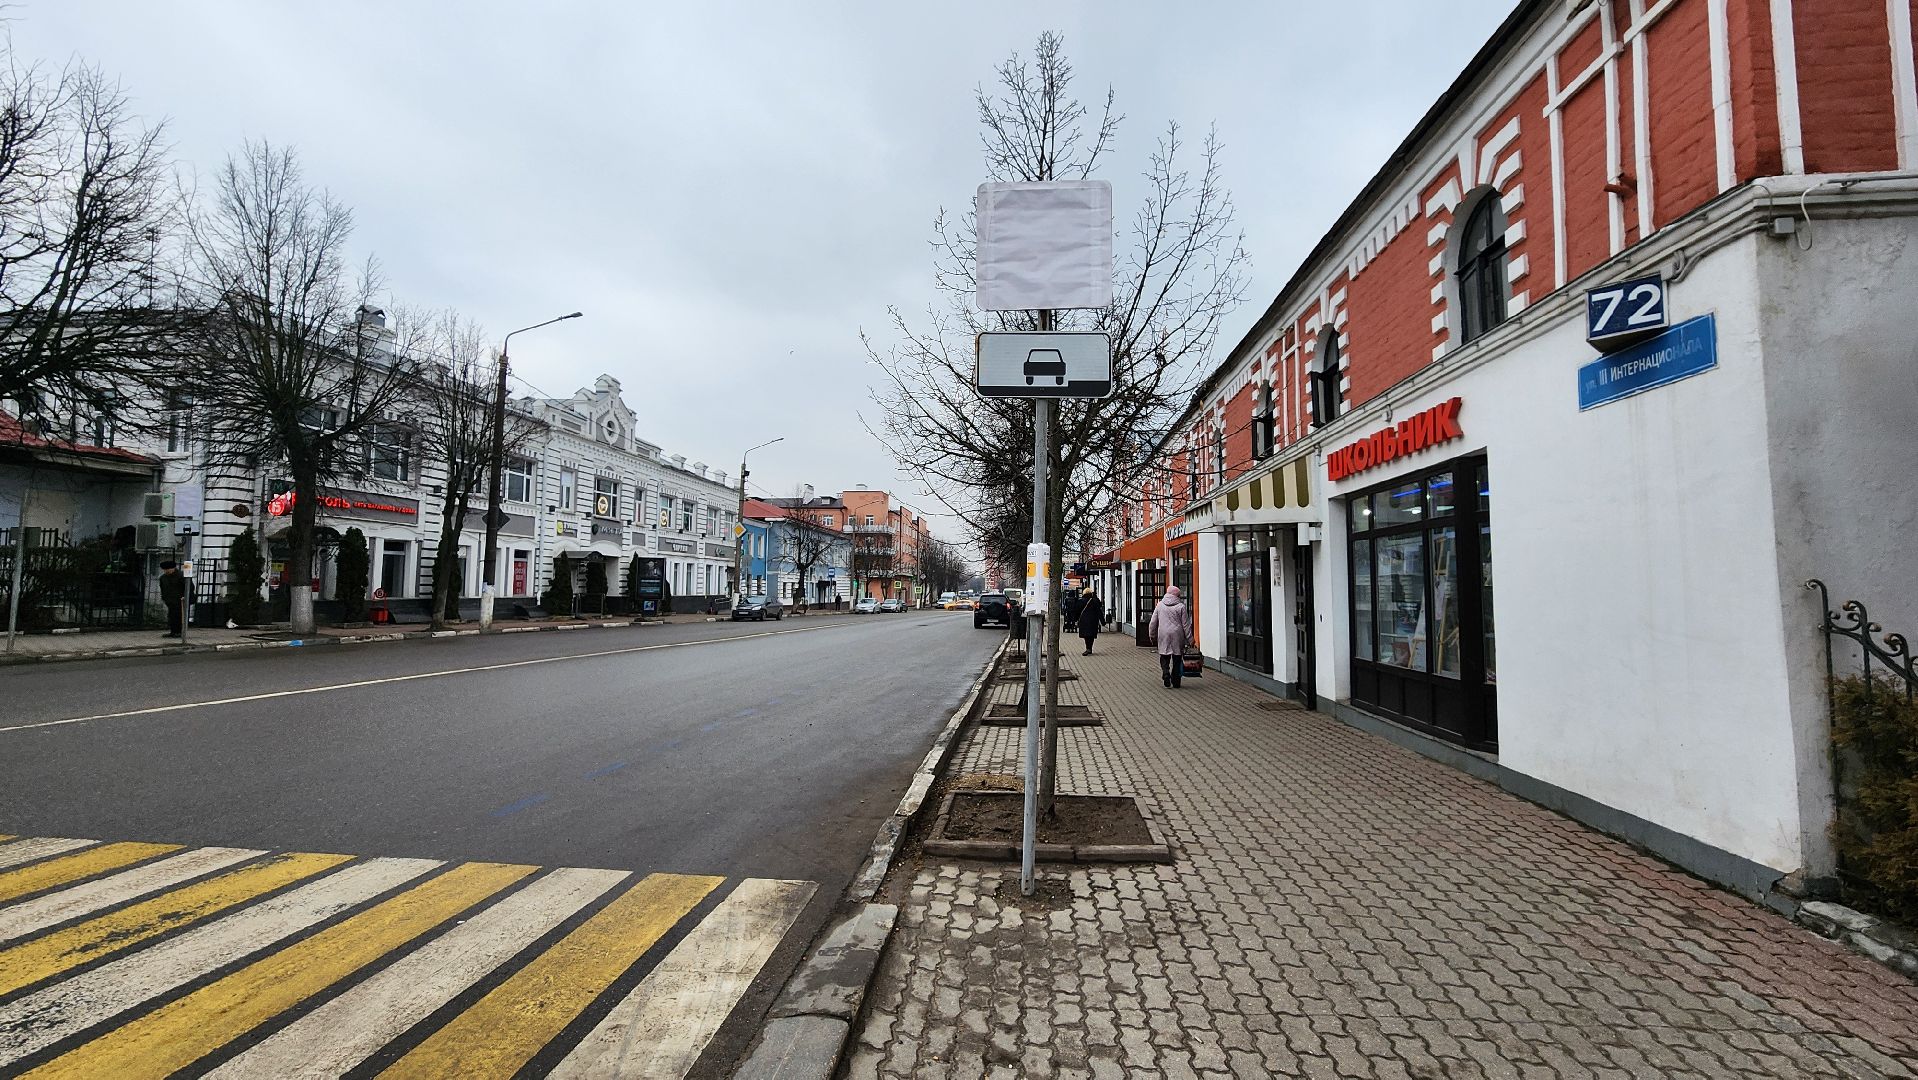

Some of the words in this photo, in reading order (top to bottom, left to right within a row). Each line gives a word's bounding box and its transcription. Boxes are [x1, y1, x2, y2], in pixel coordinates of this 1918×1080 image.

[1592, 283, 1662, 332] 72
[1610, 337, 1703, 381] ИНТЕРНАЦИОНАЛА
[1327, 397, 1465, 482] ШКОЛЬНИК
